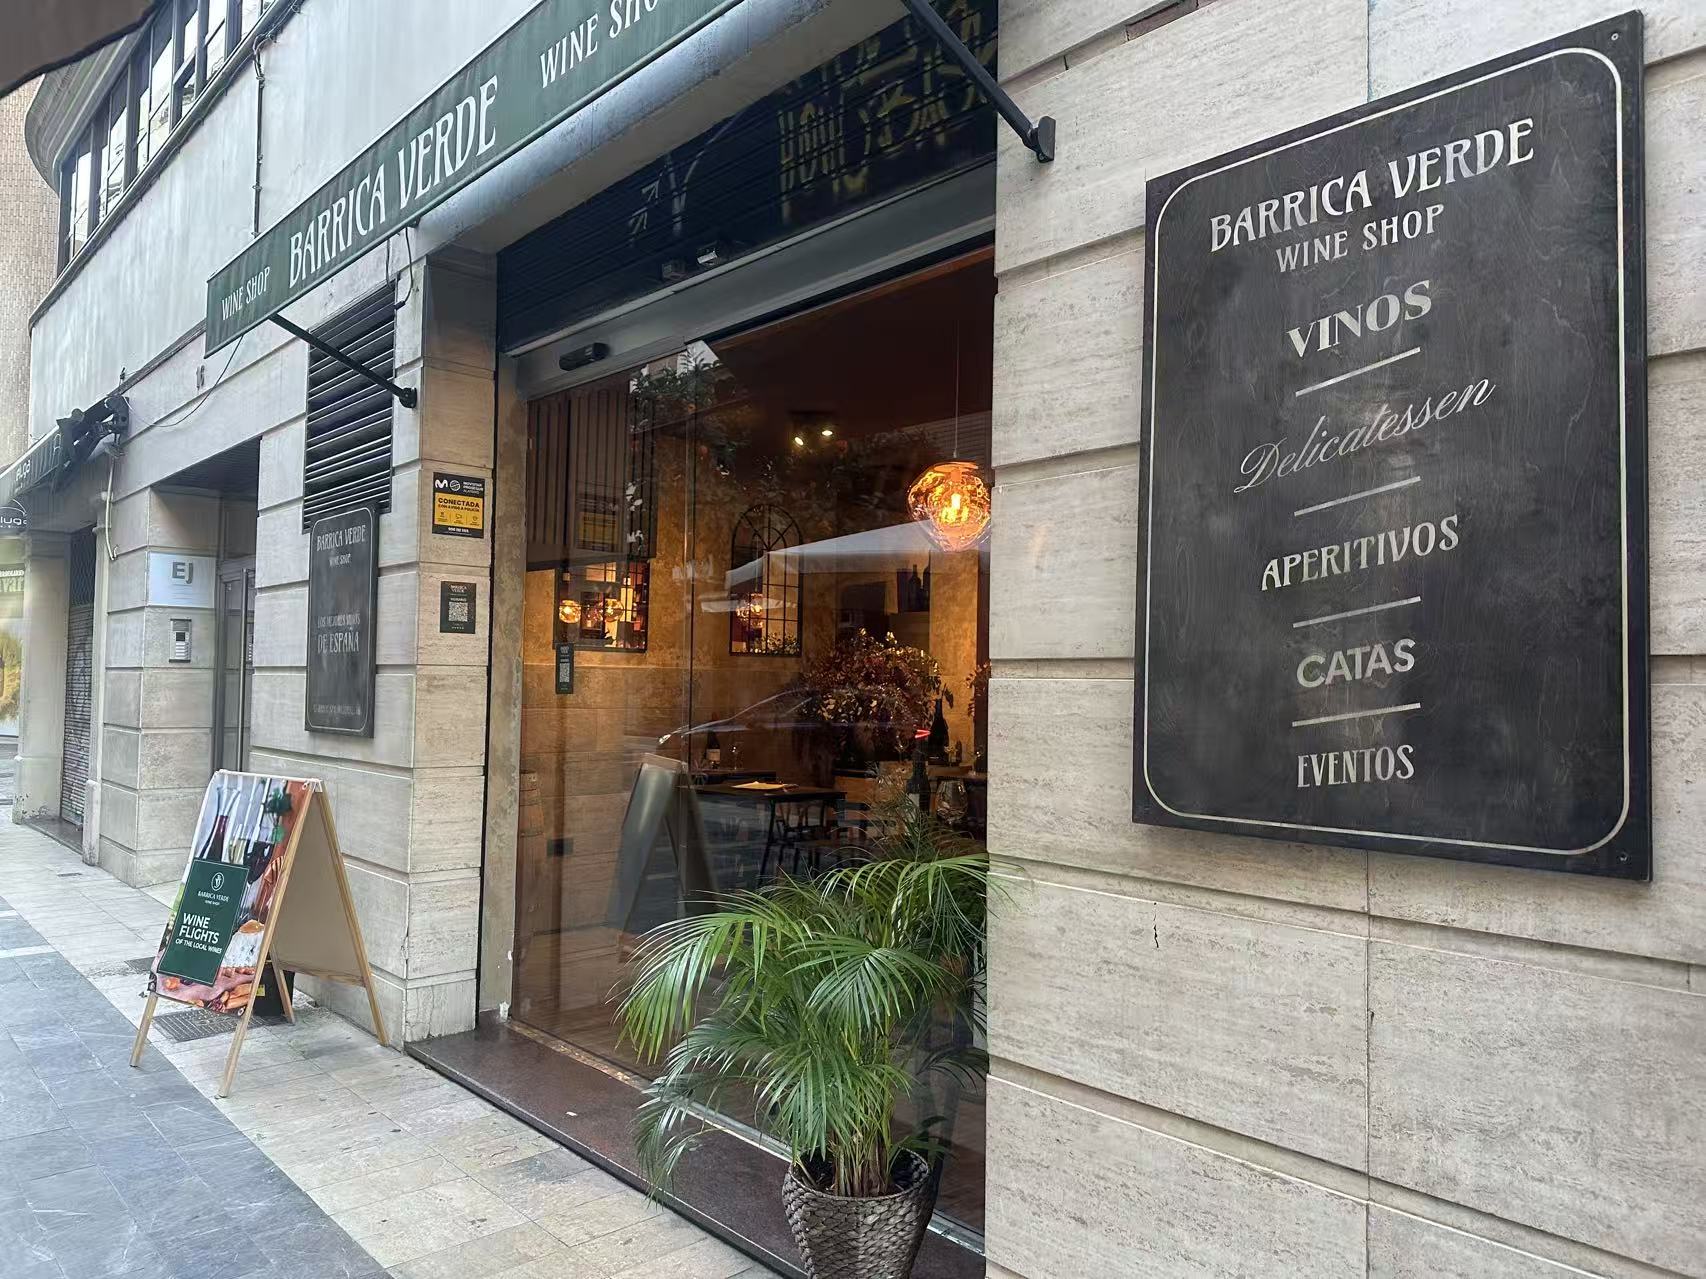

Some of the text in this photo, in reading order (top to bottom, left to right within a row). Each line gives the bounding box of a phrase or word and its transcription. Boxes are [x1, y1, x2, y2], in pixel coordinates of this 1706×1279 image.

[540, 0, 659, 88] WINE SH
[289, 75, 498, 289] BARRICA VERDE
[1210, 118, 1535, 253] BARRICA VERDE
[1276, 204, 1445, 273] WINE SHOP
[221, 266, 270, 320] WINE SHOP
[1287, 279, 1432, 358] VINOS
[1233, 379, 1497, 493] Delicatessen
[438, 497, 480, 508] CONECTADA
[316, 524, 366, 552] BARRICA VERDE
[1261, 514, 1460, 591] APERITIVOS
[172, 561, 194, 585] EJ
[317, 626, 360, 654] DE ESPAÑA
[1296, 638, 1416, 688] CATAS
[1297, 744, 1416, 788] EVENTOS
[178, 925, 220, 944] FLIGHTS
[183, 912, 211, 929] WINE
[175, 938, 223, 954] OF THE LOCAL WINES
